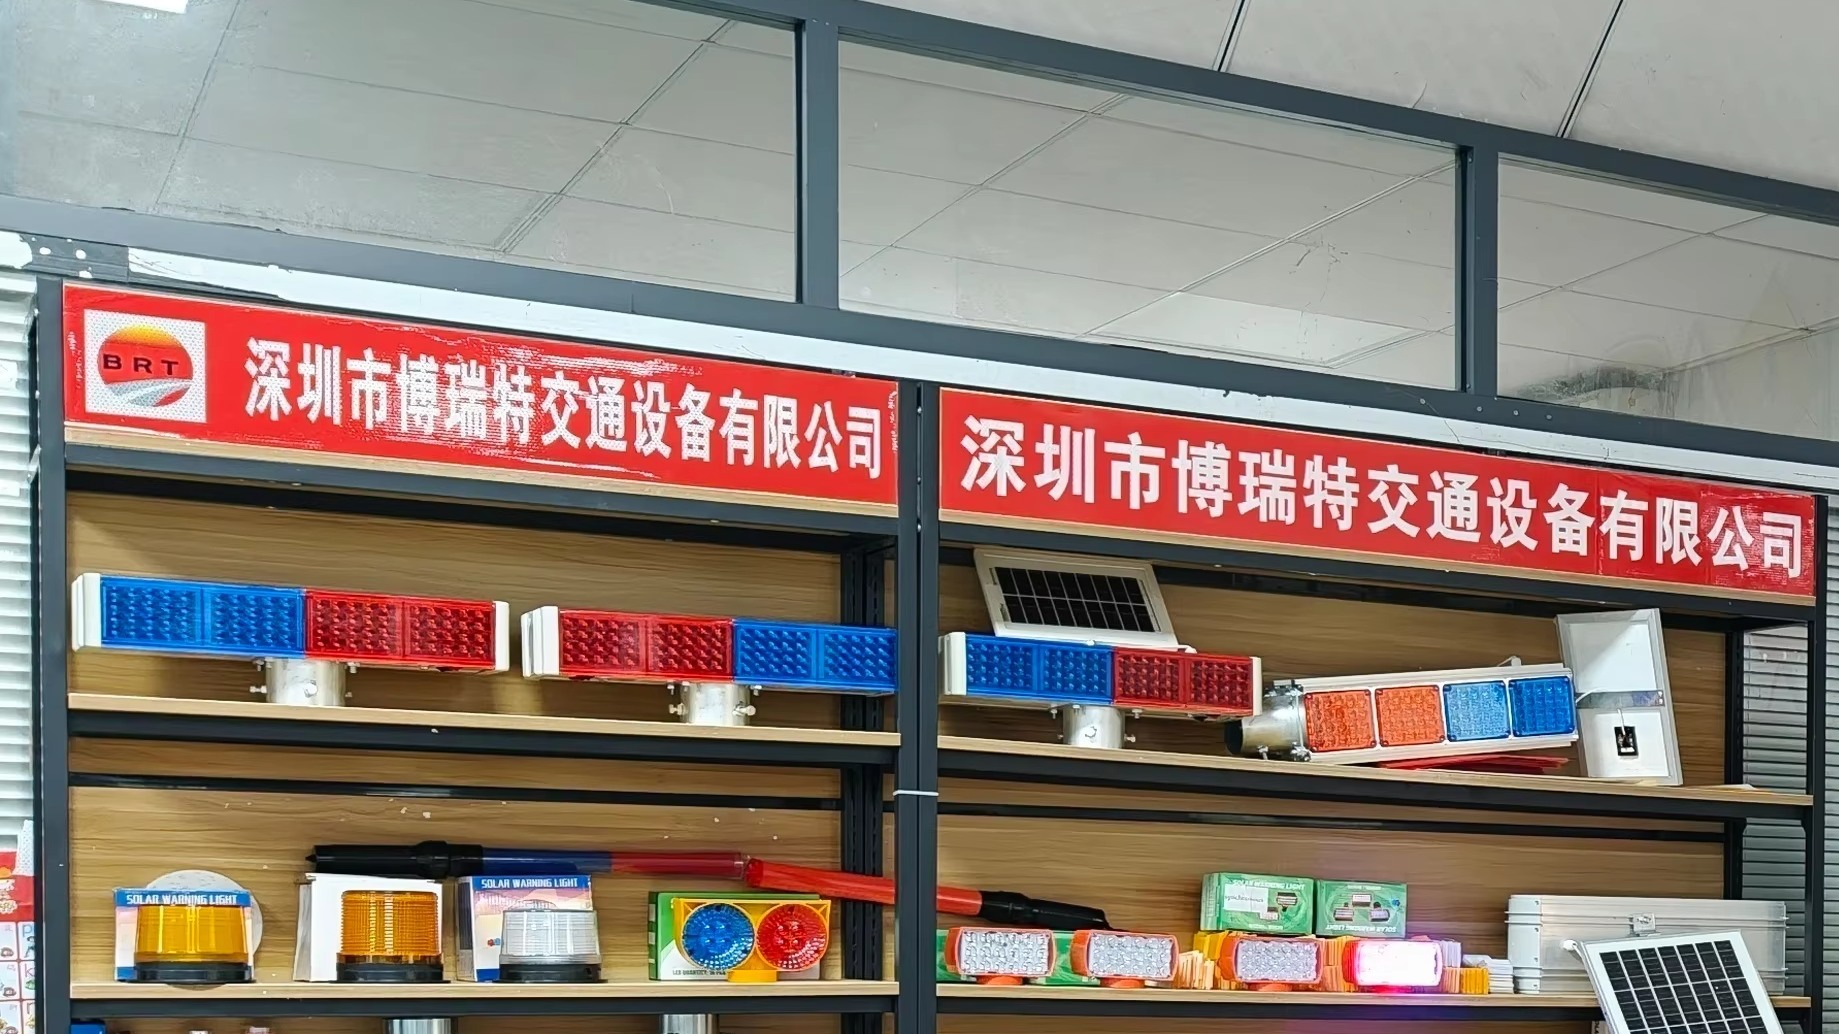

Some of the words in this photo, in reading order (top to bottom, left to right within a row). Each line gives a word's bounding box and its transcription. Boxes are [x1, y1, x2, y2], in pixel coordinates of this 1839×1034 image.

[103, 353, 179, 376] BRT
[244, 336, 882, 480] 深圳市博瑞特交通设备有限公司
[960, 415, 1804, 580] 深圳市博瑞特交通设备有限公司
[481, 878, 510, 890] SOLAR
[512, 878, 553, 889] WARNING
[554, 877, 579, 888] LIGHT
[126, 894, 159, 905] SOLAR
[162, 895, 207, 906] WARNING
[209, 895, 238, 905] LIGHT
